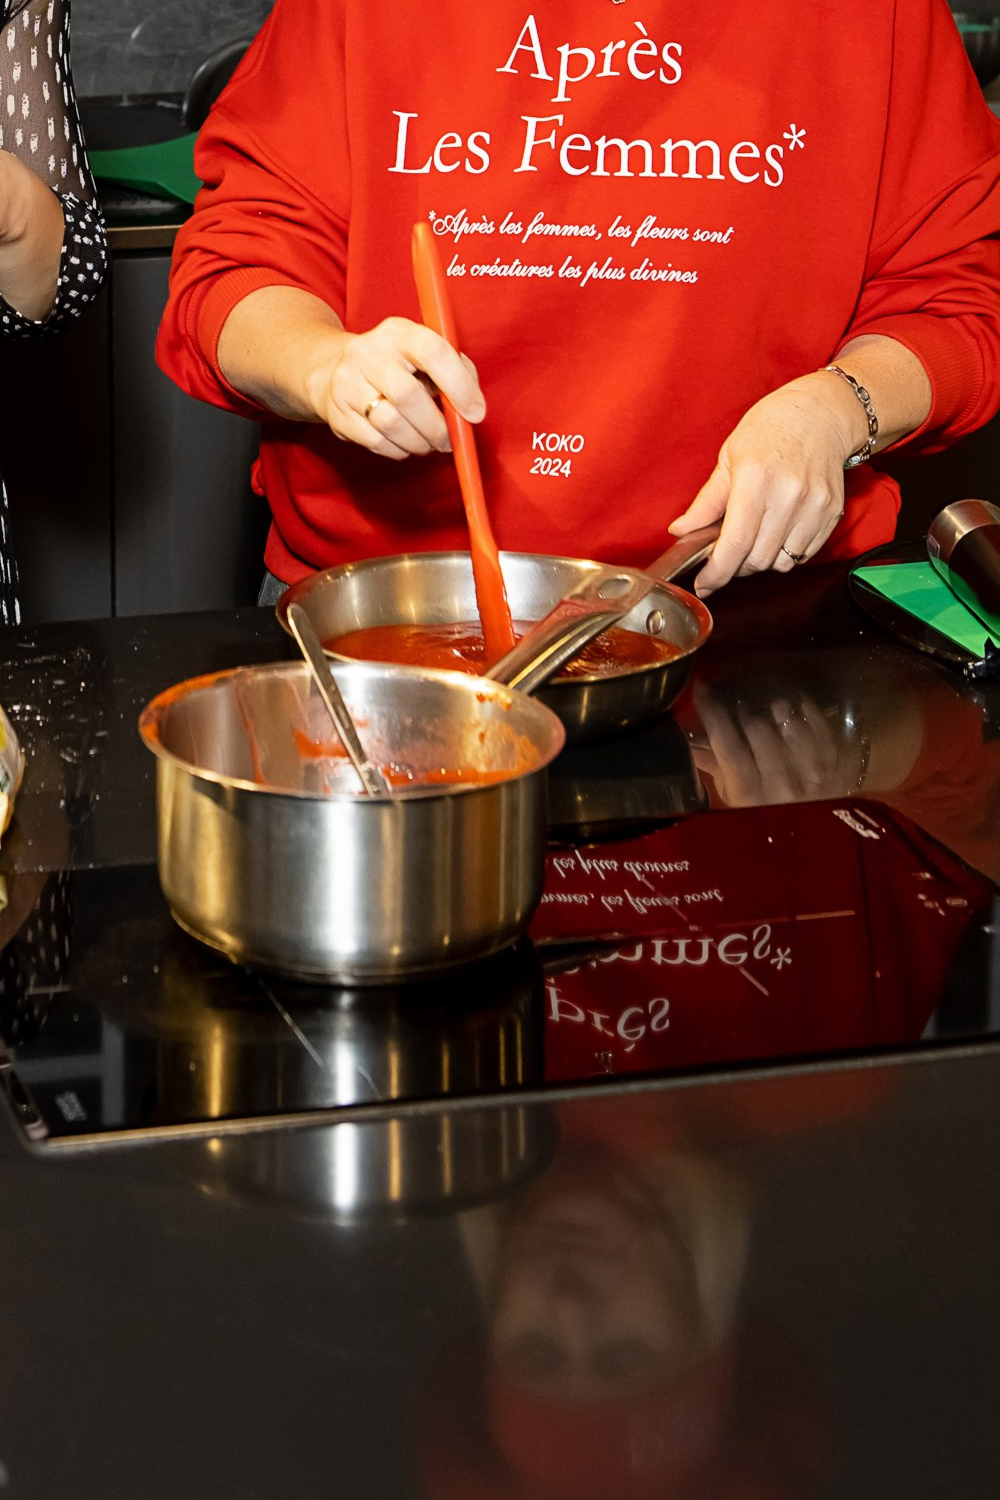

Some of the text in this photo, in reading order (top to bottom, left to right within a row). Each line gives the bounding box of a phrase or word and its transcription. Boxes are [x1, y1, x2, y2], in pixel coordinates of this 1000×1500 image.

[496, 14, 683, 103] Après
[387, 110, 491, 175] Les
[499, 211, 524, 236] les
[521, 212, 602, 244] femmes,
[607, 215, 632, 239] les
[630, 216, 690, 247] fleurs
[692, 224, 735, 245] sont
[446, 254, 700, 288] les créatures les plus divines
[531, 431, 585, 453] KOKO
[529, 457, 572, 478] 2024
